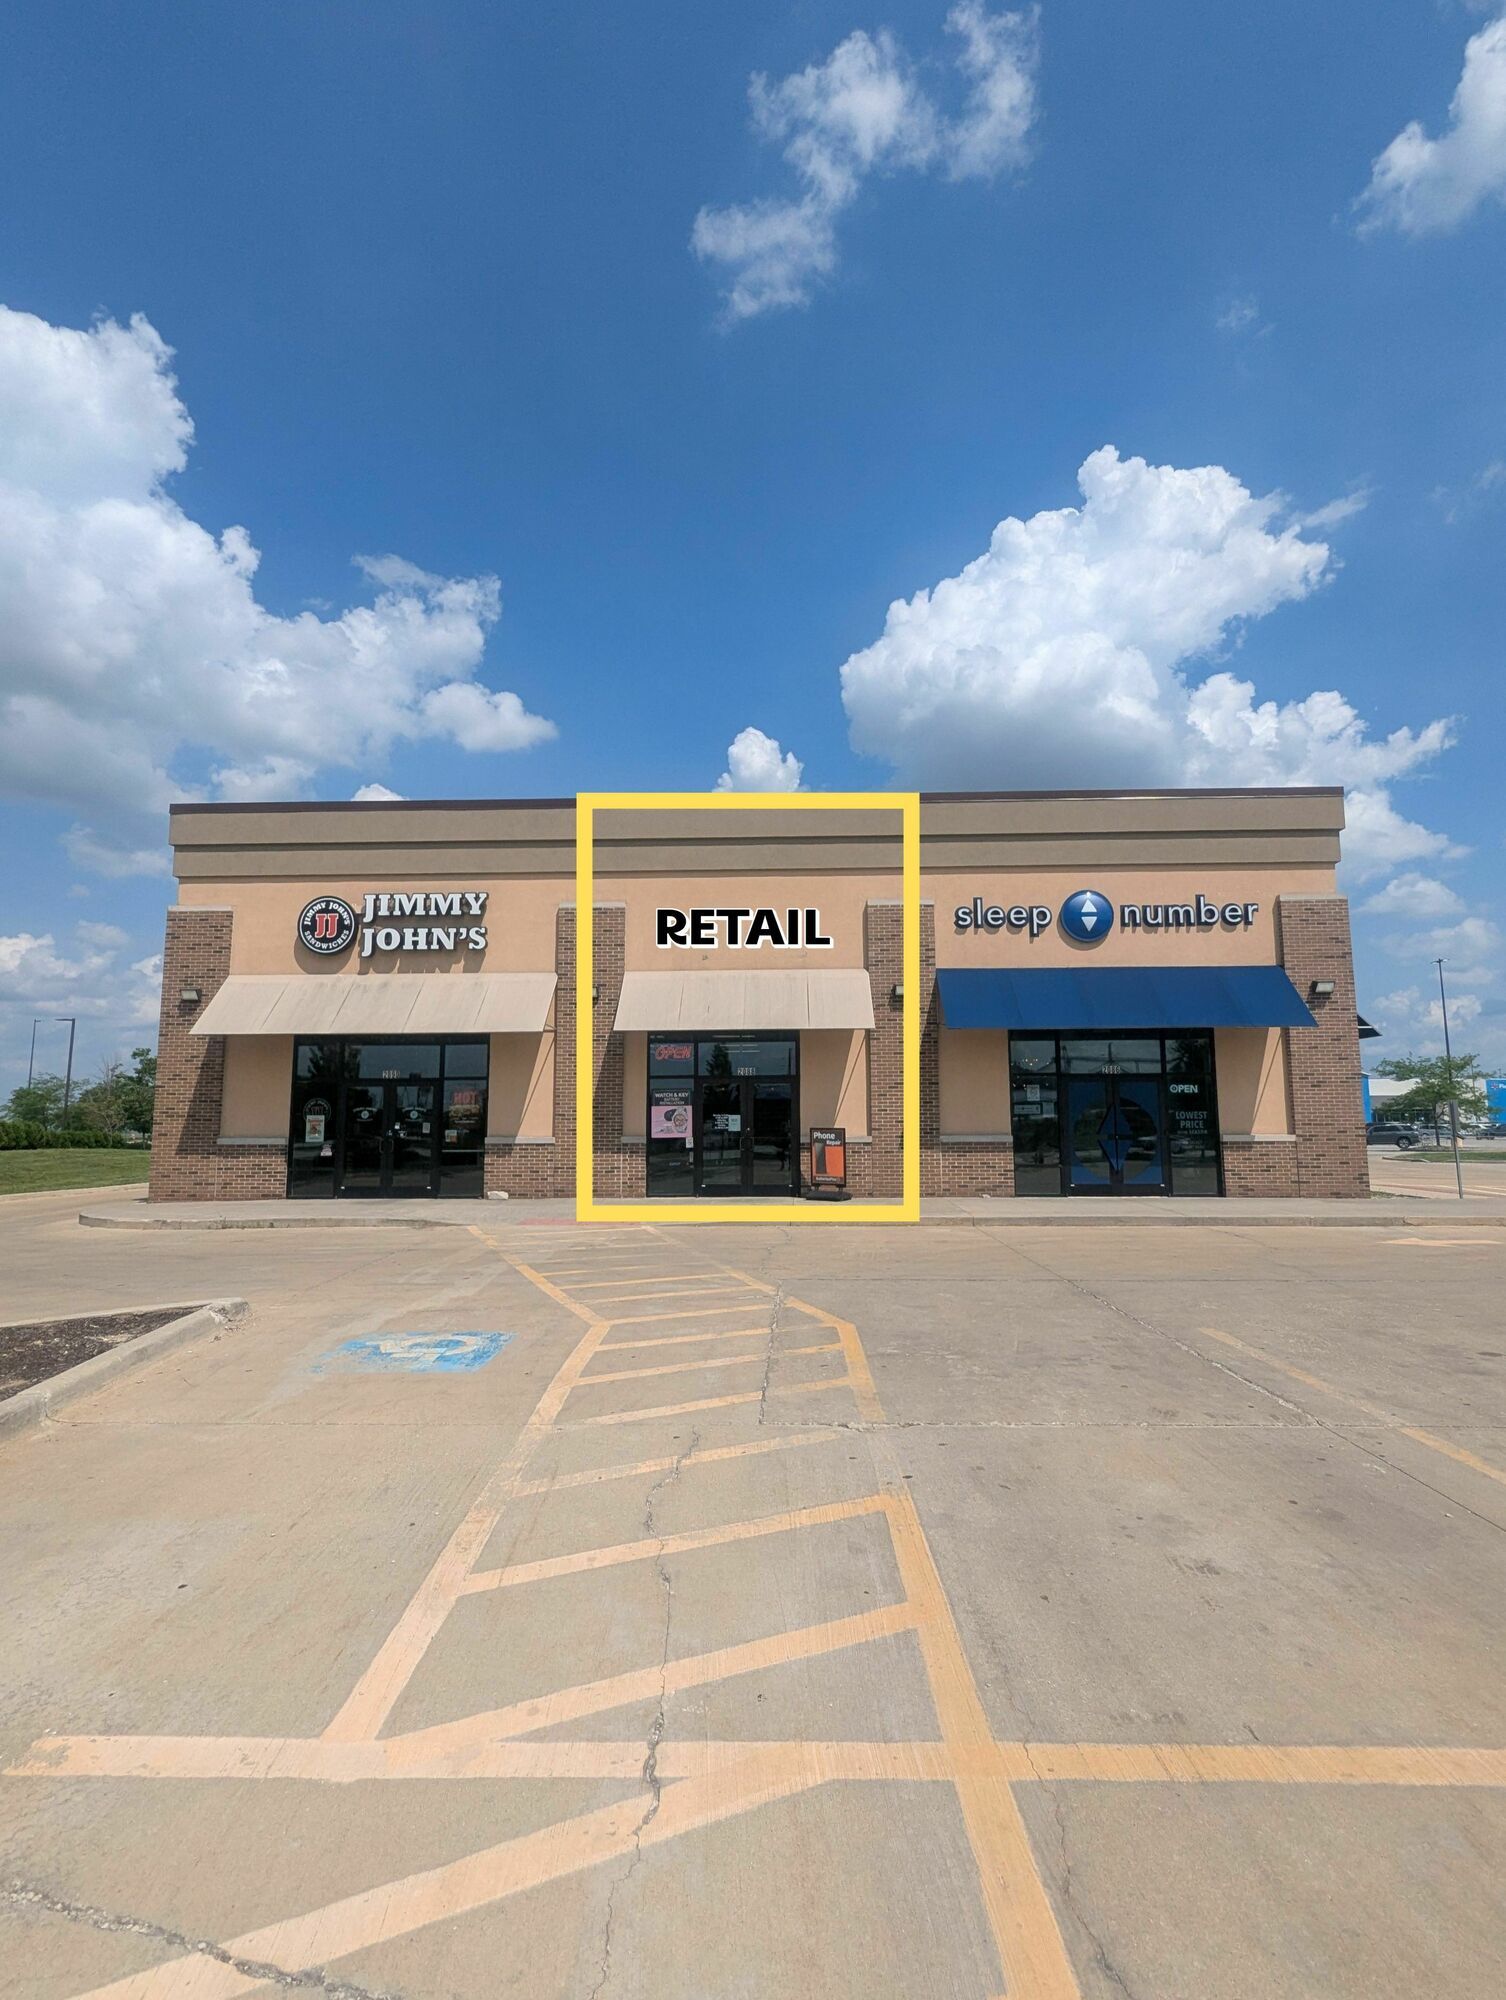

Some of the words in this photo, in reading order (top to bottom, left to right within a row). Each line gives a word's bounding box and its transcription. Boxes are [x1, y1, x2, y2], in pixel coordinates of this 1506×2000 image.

[304, 902, 326, 926] JIMMY
[328, 902, 351, 926] JOHN'S
[362, 892, 489, 923] JIMMY
[955, 897, 1052, 937] sleep
[1120, 894, 1258, 928] number
[314, 913, 339, 939] JJ
[304, 930, 350, 950] SANDWICHES
[361, 927, 488, 957] JOHN'S
[654, 1045, 693, 1060] OPEN
[1169, 1084, 1199, 1093] OPEN
[1175, 1111, 1208, 1120] LOWEST
[1180, 1120, 1204, 1129] PRICE
[813, 1131, 836, 1140] Phone
